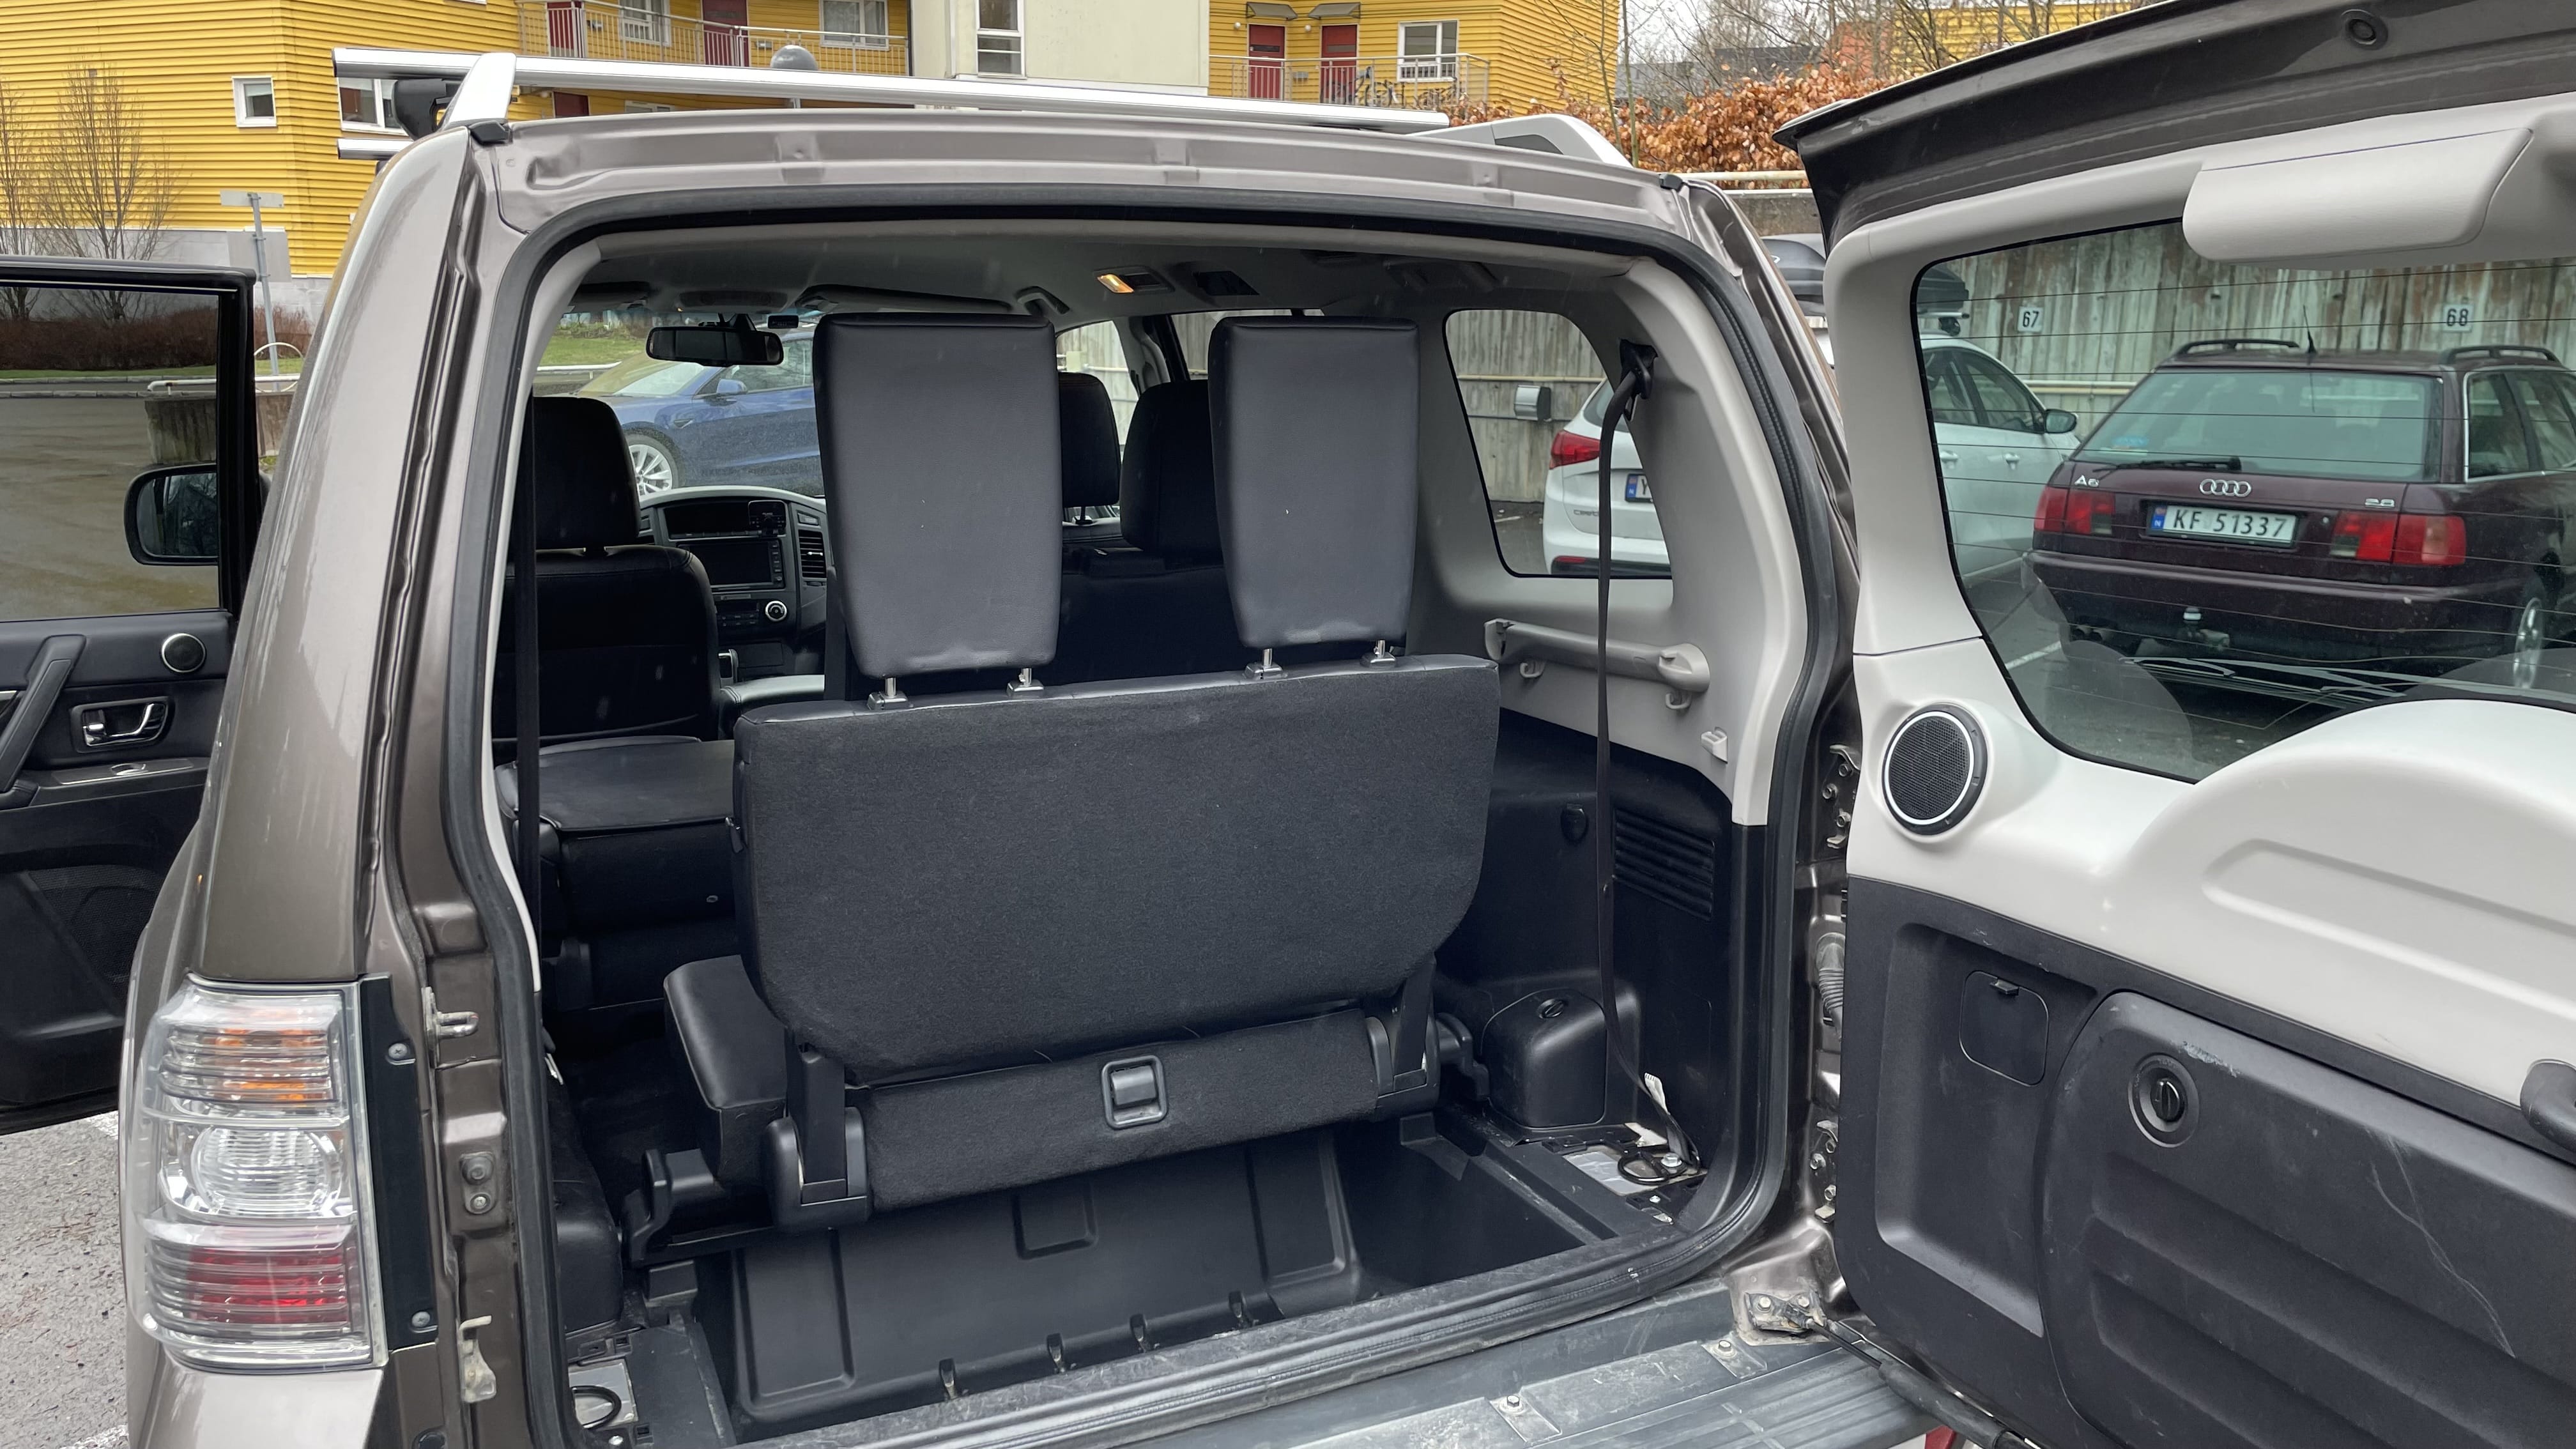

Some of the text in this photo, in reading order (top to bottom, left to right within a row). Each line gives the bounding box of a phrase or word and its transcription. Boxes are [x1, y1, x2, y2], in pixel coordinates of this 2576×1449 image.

[2022, 310, 2039, 328] 67
[2446, 308, 2469, 327] 68
[2074, 475, 2100, 487] A6
[2173, 509, 2202, 530] KF
[2212, 513, 2287, 537] 51337
